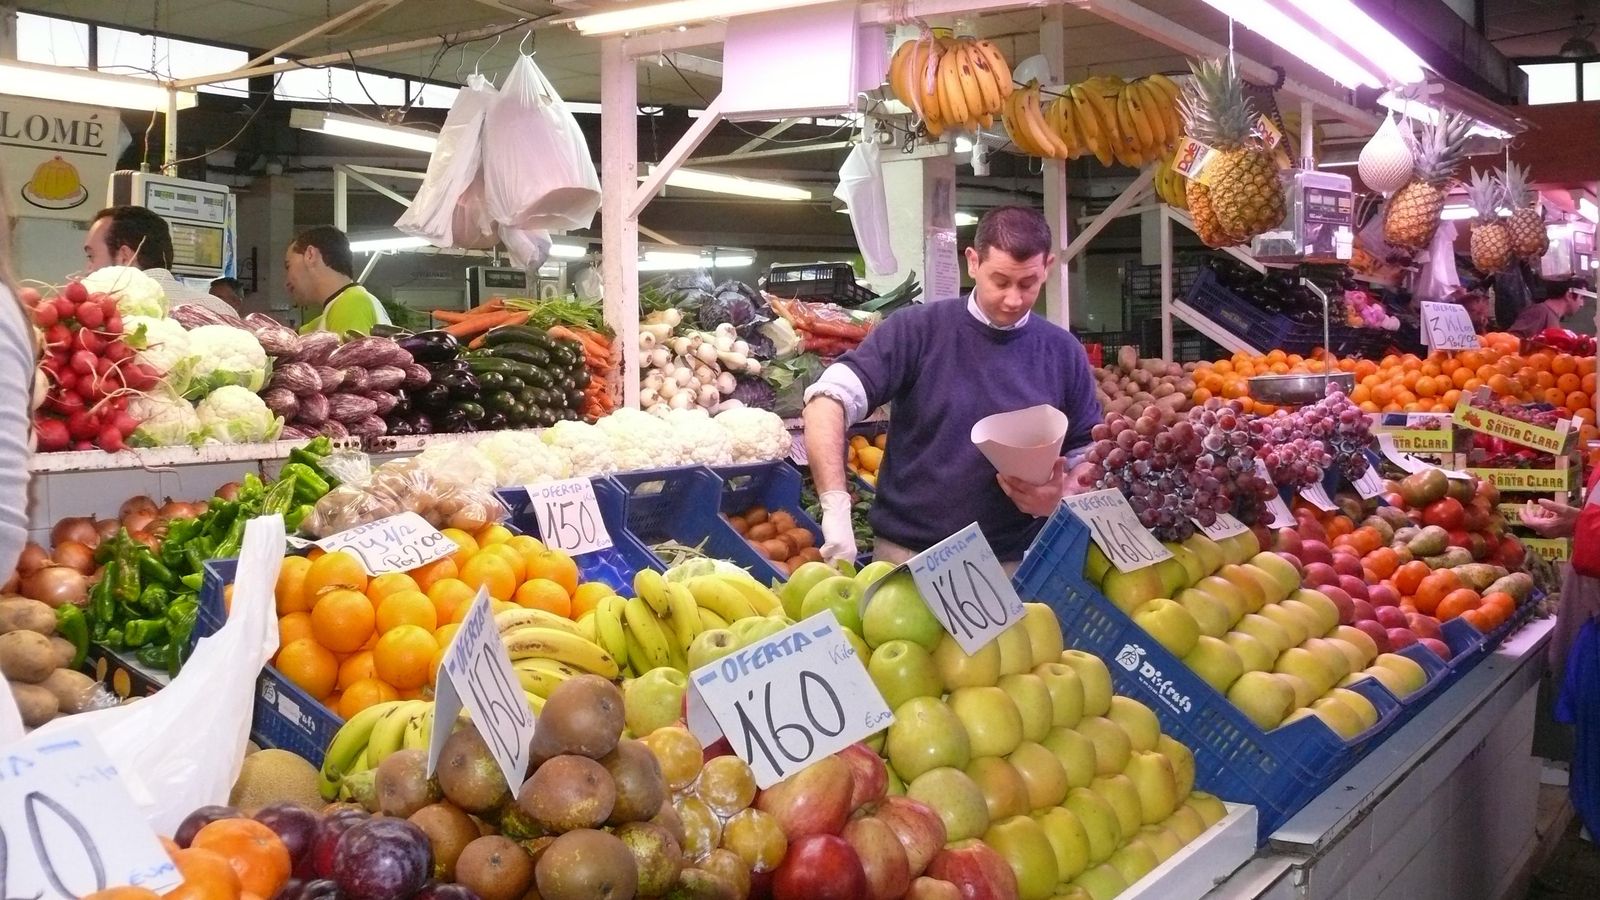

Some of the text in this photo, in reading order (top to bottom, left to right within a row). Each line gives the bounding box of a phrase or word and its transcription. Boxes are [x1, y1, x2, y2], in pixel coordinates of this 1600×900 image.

[0, 111, 104, 148] LOMÉ
[1258, 121, 1275, 145] Dole
[1177, 142, 1198, 171] Dole
[1430, 316, 1446, 346] 3
[1413, 437, 1449, 449] CLARA
[1485, 418, 1561, 450] SANTA CLARA
[541, 483, 583, 498] OFERTA
[1488, 473, 1564, 488] SANTA CLARA
[926, 540, 968, 572] OFERTA
[455, 604, 486, 676] OFERTA
[720, 631, 814, 684] OFERTA
[733, 670, 846, 778] 1'60
